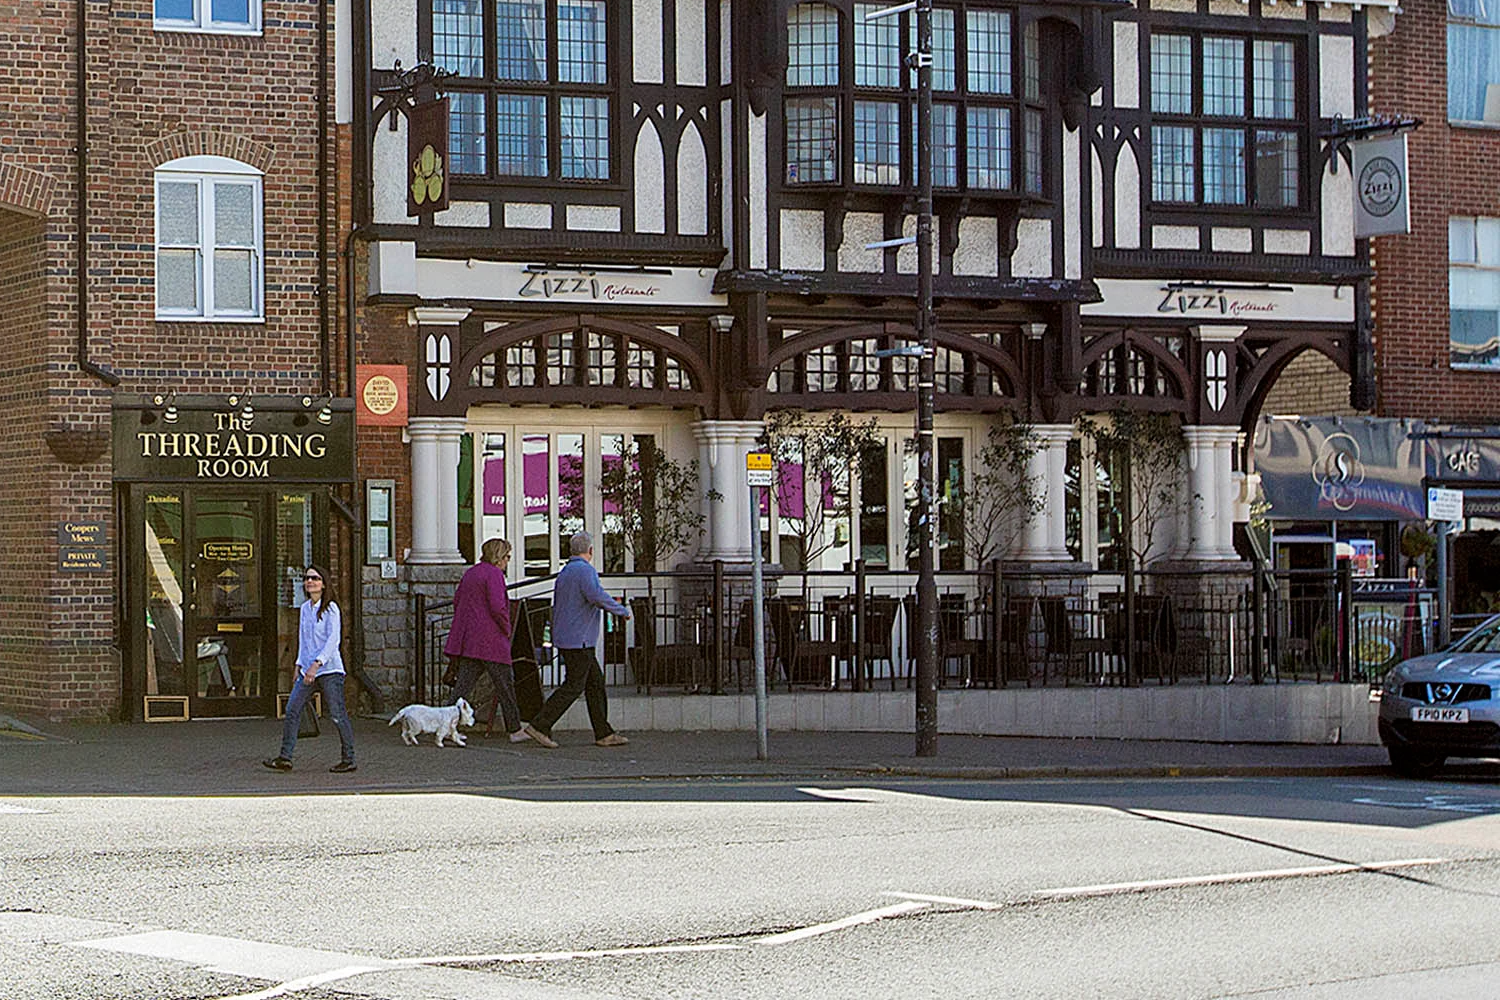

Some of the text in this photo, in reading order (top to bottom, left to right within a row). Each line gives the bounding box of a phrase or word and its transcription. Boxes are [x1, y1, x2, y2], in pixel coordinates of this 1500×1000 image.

[213, 412, 254, 432] The
[137, 432, 326, 458] THREADING
[197, 458, 270, 478] ROOM
[64, 522, 100, 534] Coopers
[71, 533, 95, 542] Mews
[67, 552, 97, 560] PRIVATE
